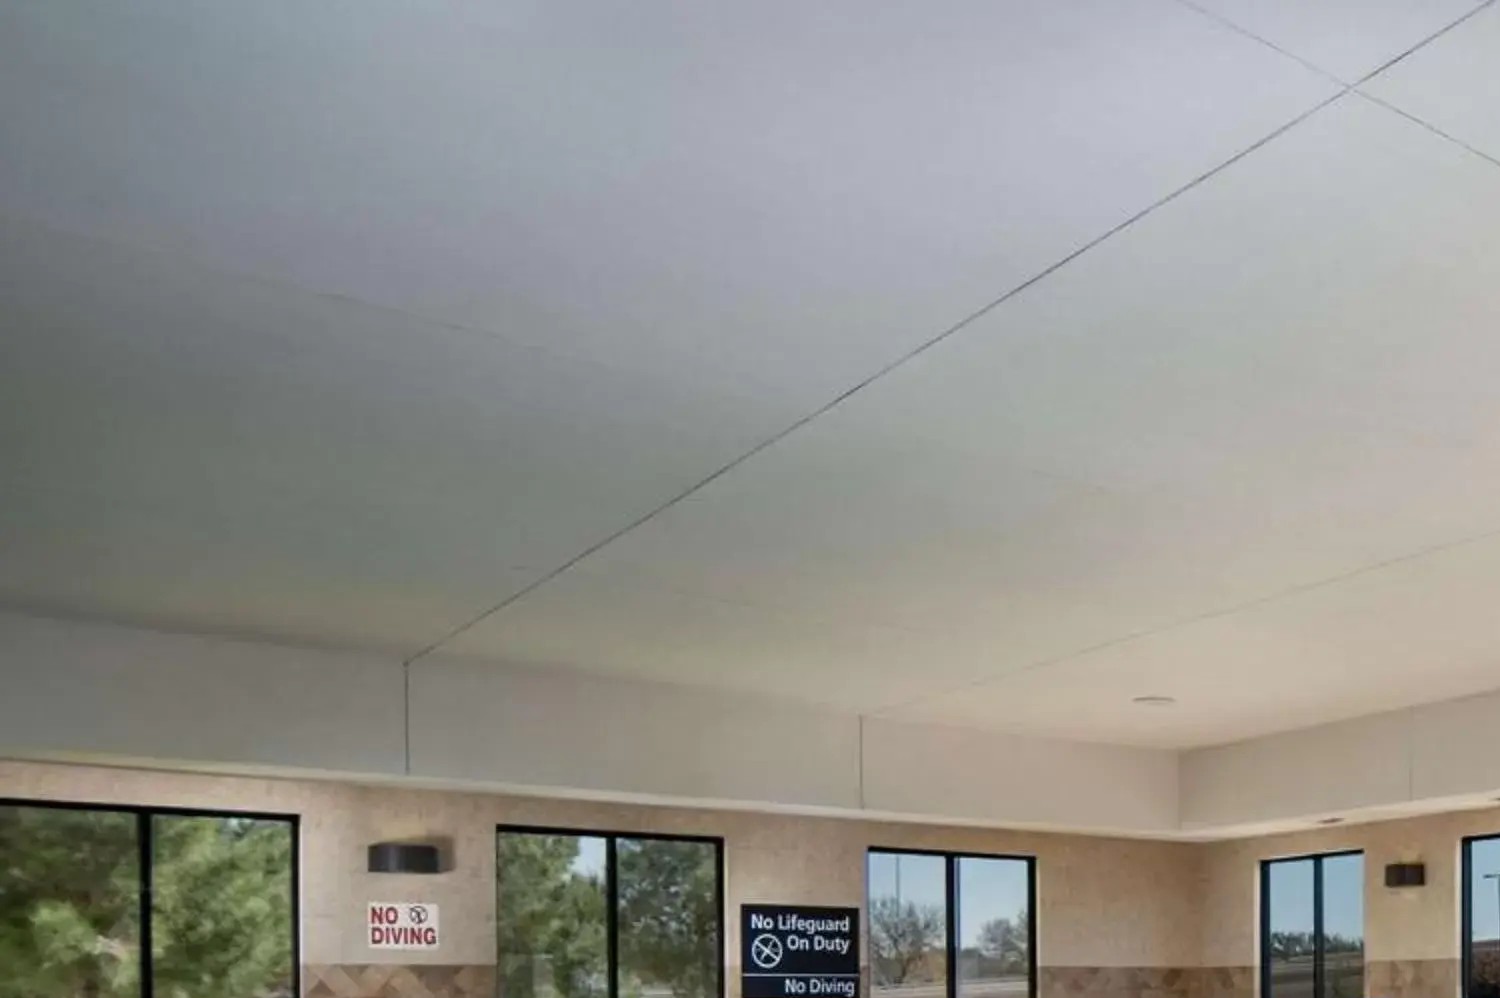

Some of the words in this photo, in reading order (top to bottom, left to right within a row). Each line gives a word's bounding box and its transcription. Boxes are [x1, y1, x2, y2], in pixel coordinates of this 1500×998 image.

[371, 906, 399, 924] NO
[751, 913, 774, 930] No
[778, 914, 851, 935] Lifeguard
[371, 927, 437, 945] DIVING
[787, 934, 809, 951] On
[813, 935, 851, 955] Duty
[785, 979, 805, 994] No
[809, 979, 855, 998] Diving
